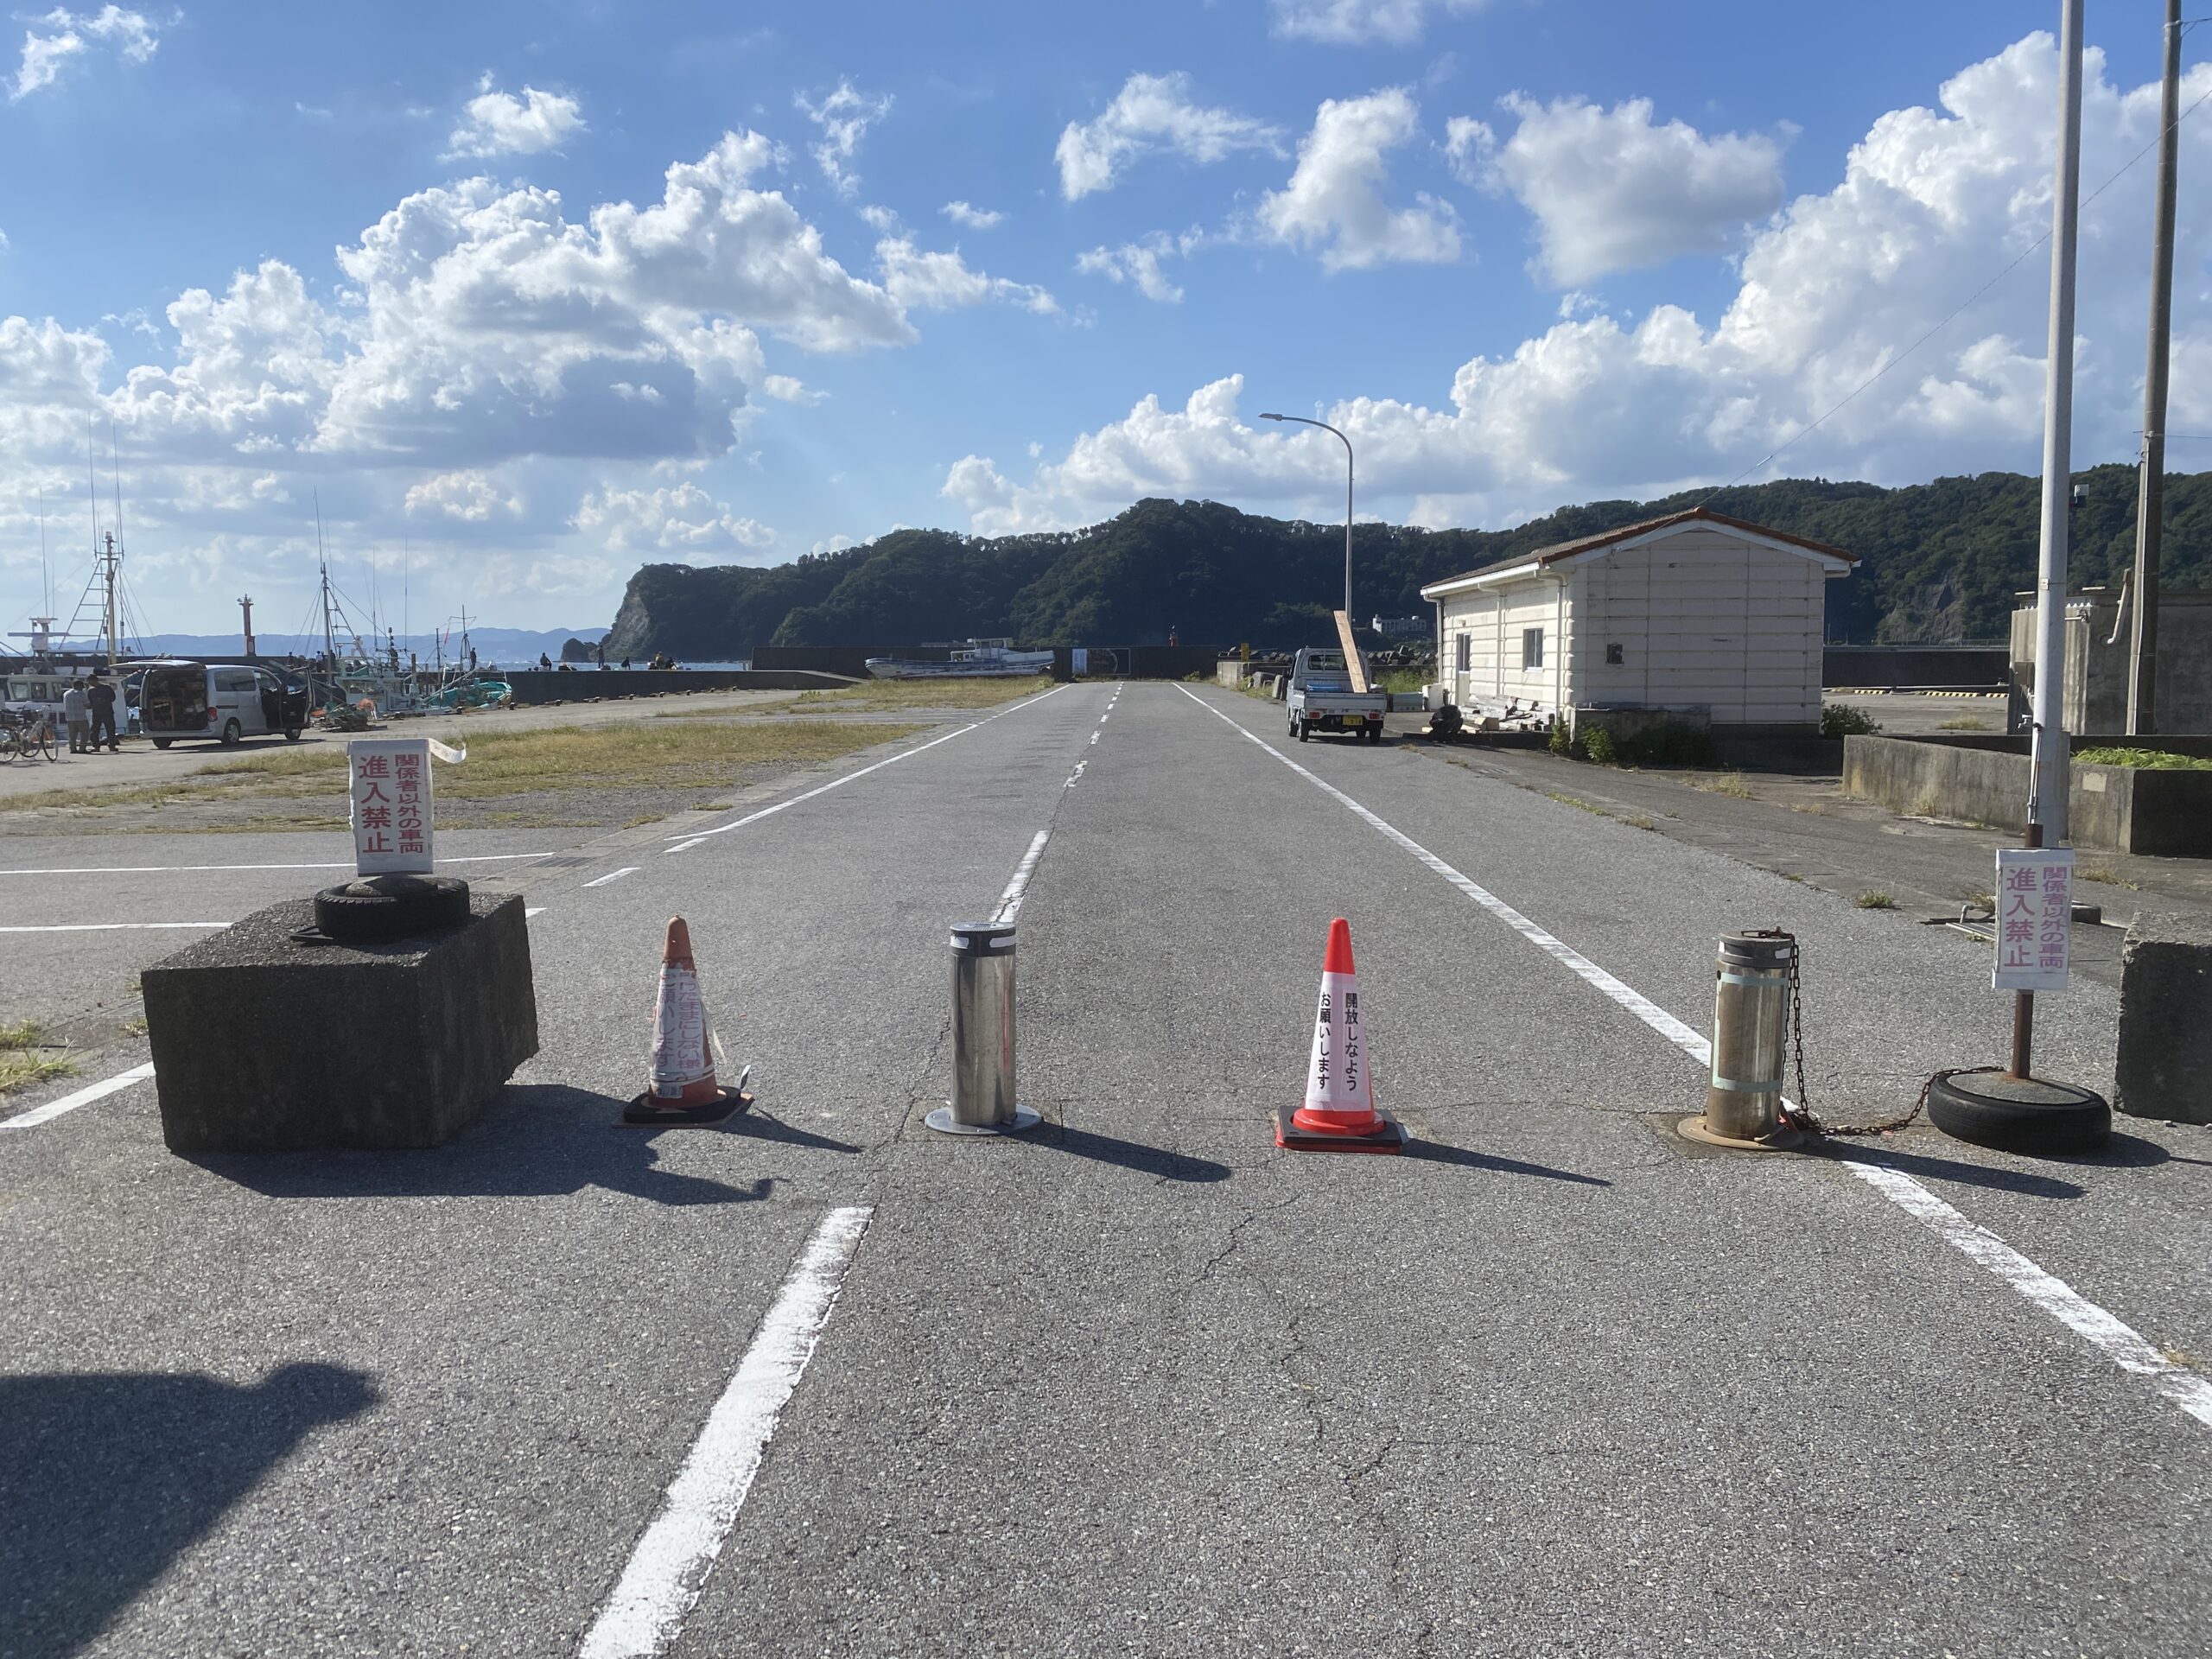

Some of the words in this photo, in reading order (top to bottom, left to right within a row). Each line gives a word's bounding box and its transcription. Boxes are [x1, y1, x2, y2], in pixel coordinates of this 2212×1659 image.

[359, 755, 393, 853] 進入禁止
[395, 754, 423, 854] 関係者以外の車両
[2004, 868, 2037, 967] 進入禁止
[2040, 867, 2068, 969] 関係者以外の車両
[1318, 992, 1331, 1090] お願いします
[1344, 993, 1358, 1091] 開放しなよう
